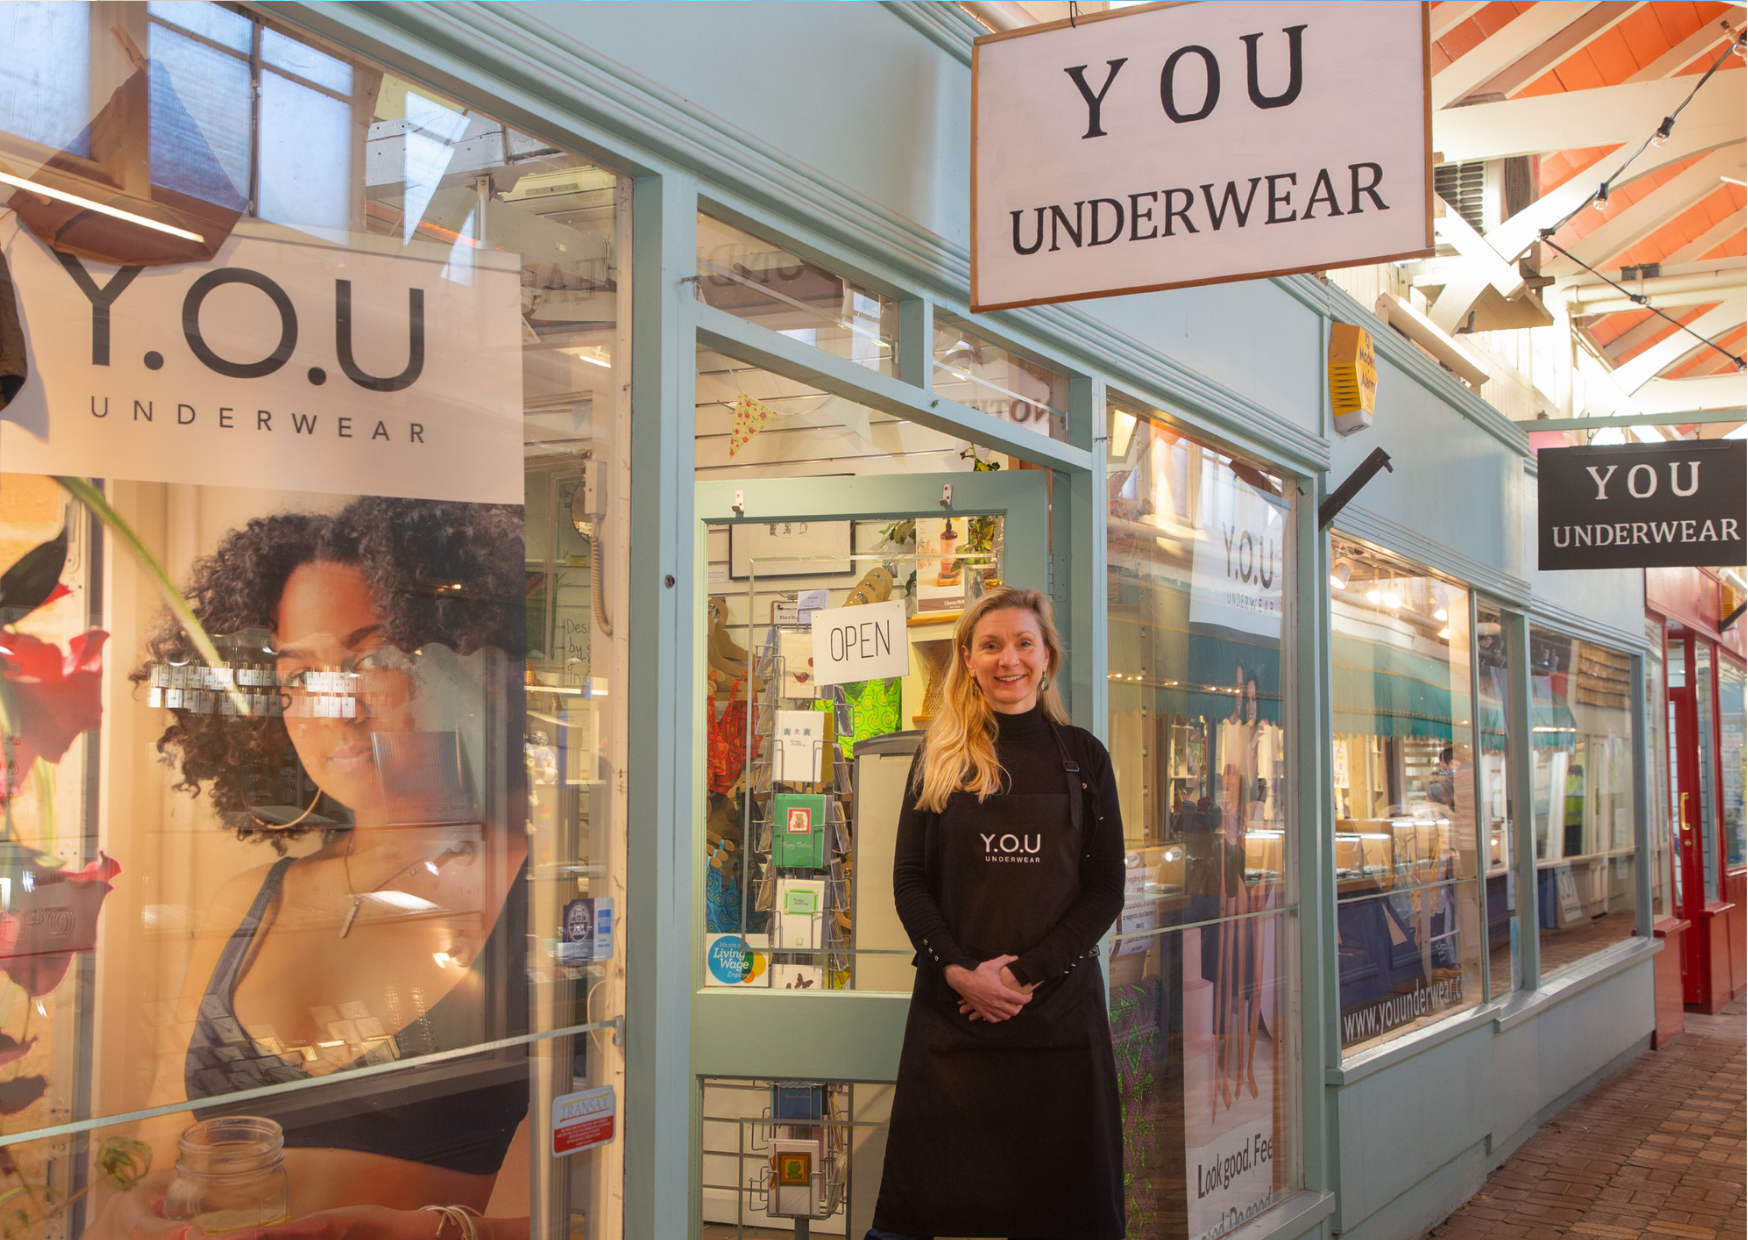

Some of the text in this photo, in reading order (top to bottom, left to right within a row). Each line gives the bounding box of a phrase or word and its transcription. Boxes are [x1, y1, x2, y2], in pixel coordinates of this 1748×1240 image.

[1009, 161, 1391, 256] UNDERWEAR
[54, 253, 426, 393] Y.O.U
[89, 395, 426, 445] UNDERWEAR
[1585, 460, 1703, 501] YOU
[1552, 518, 1742, 549] UNDERWEAR
[1222, 522, 1274, 589] Y.O.U
[1226, 590, 1275, 615] UNDERWEAR
[829, 619, 892, 662] OPEN
[979, 832, 1042, 854] Y.O.U
[985, 855, 1041, 863] UNDERWEAR
[713, 947, 746, 961] Living
[719, 958, 749, 972] Wage
[727, 971, 751, 979] Employer
[1343, 971, 1476, 1043] www.youunderwear.com
[561, 1096, 609, 1120] TRANSAX
[1197, 1153, 1222, 1199] Look
[1223, 1137, 1252, 1190] good.
